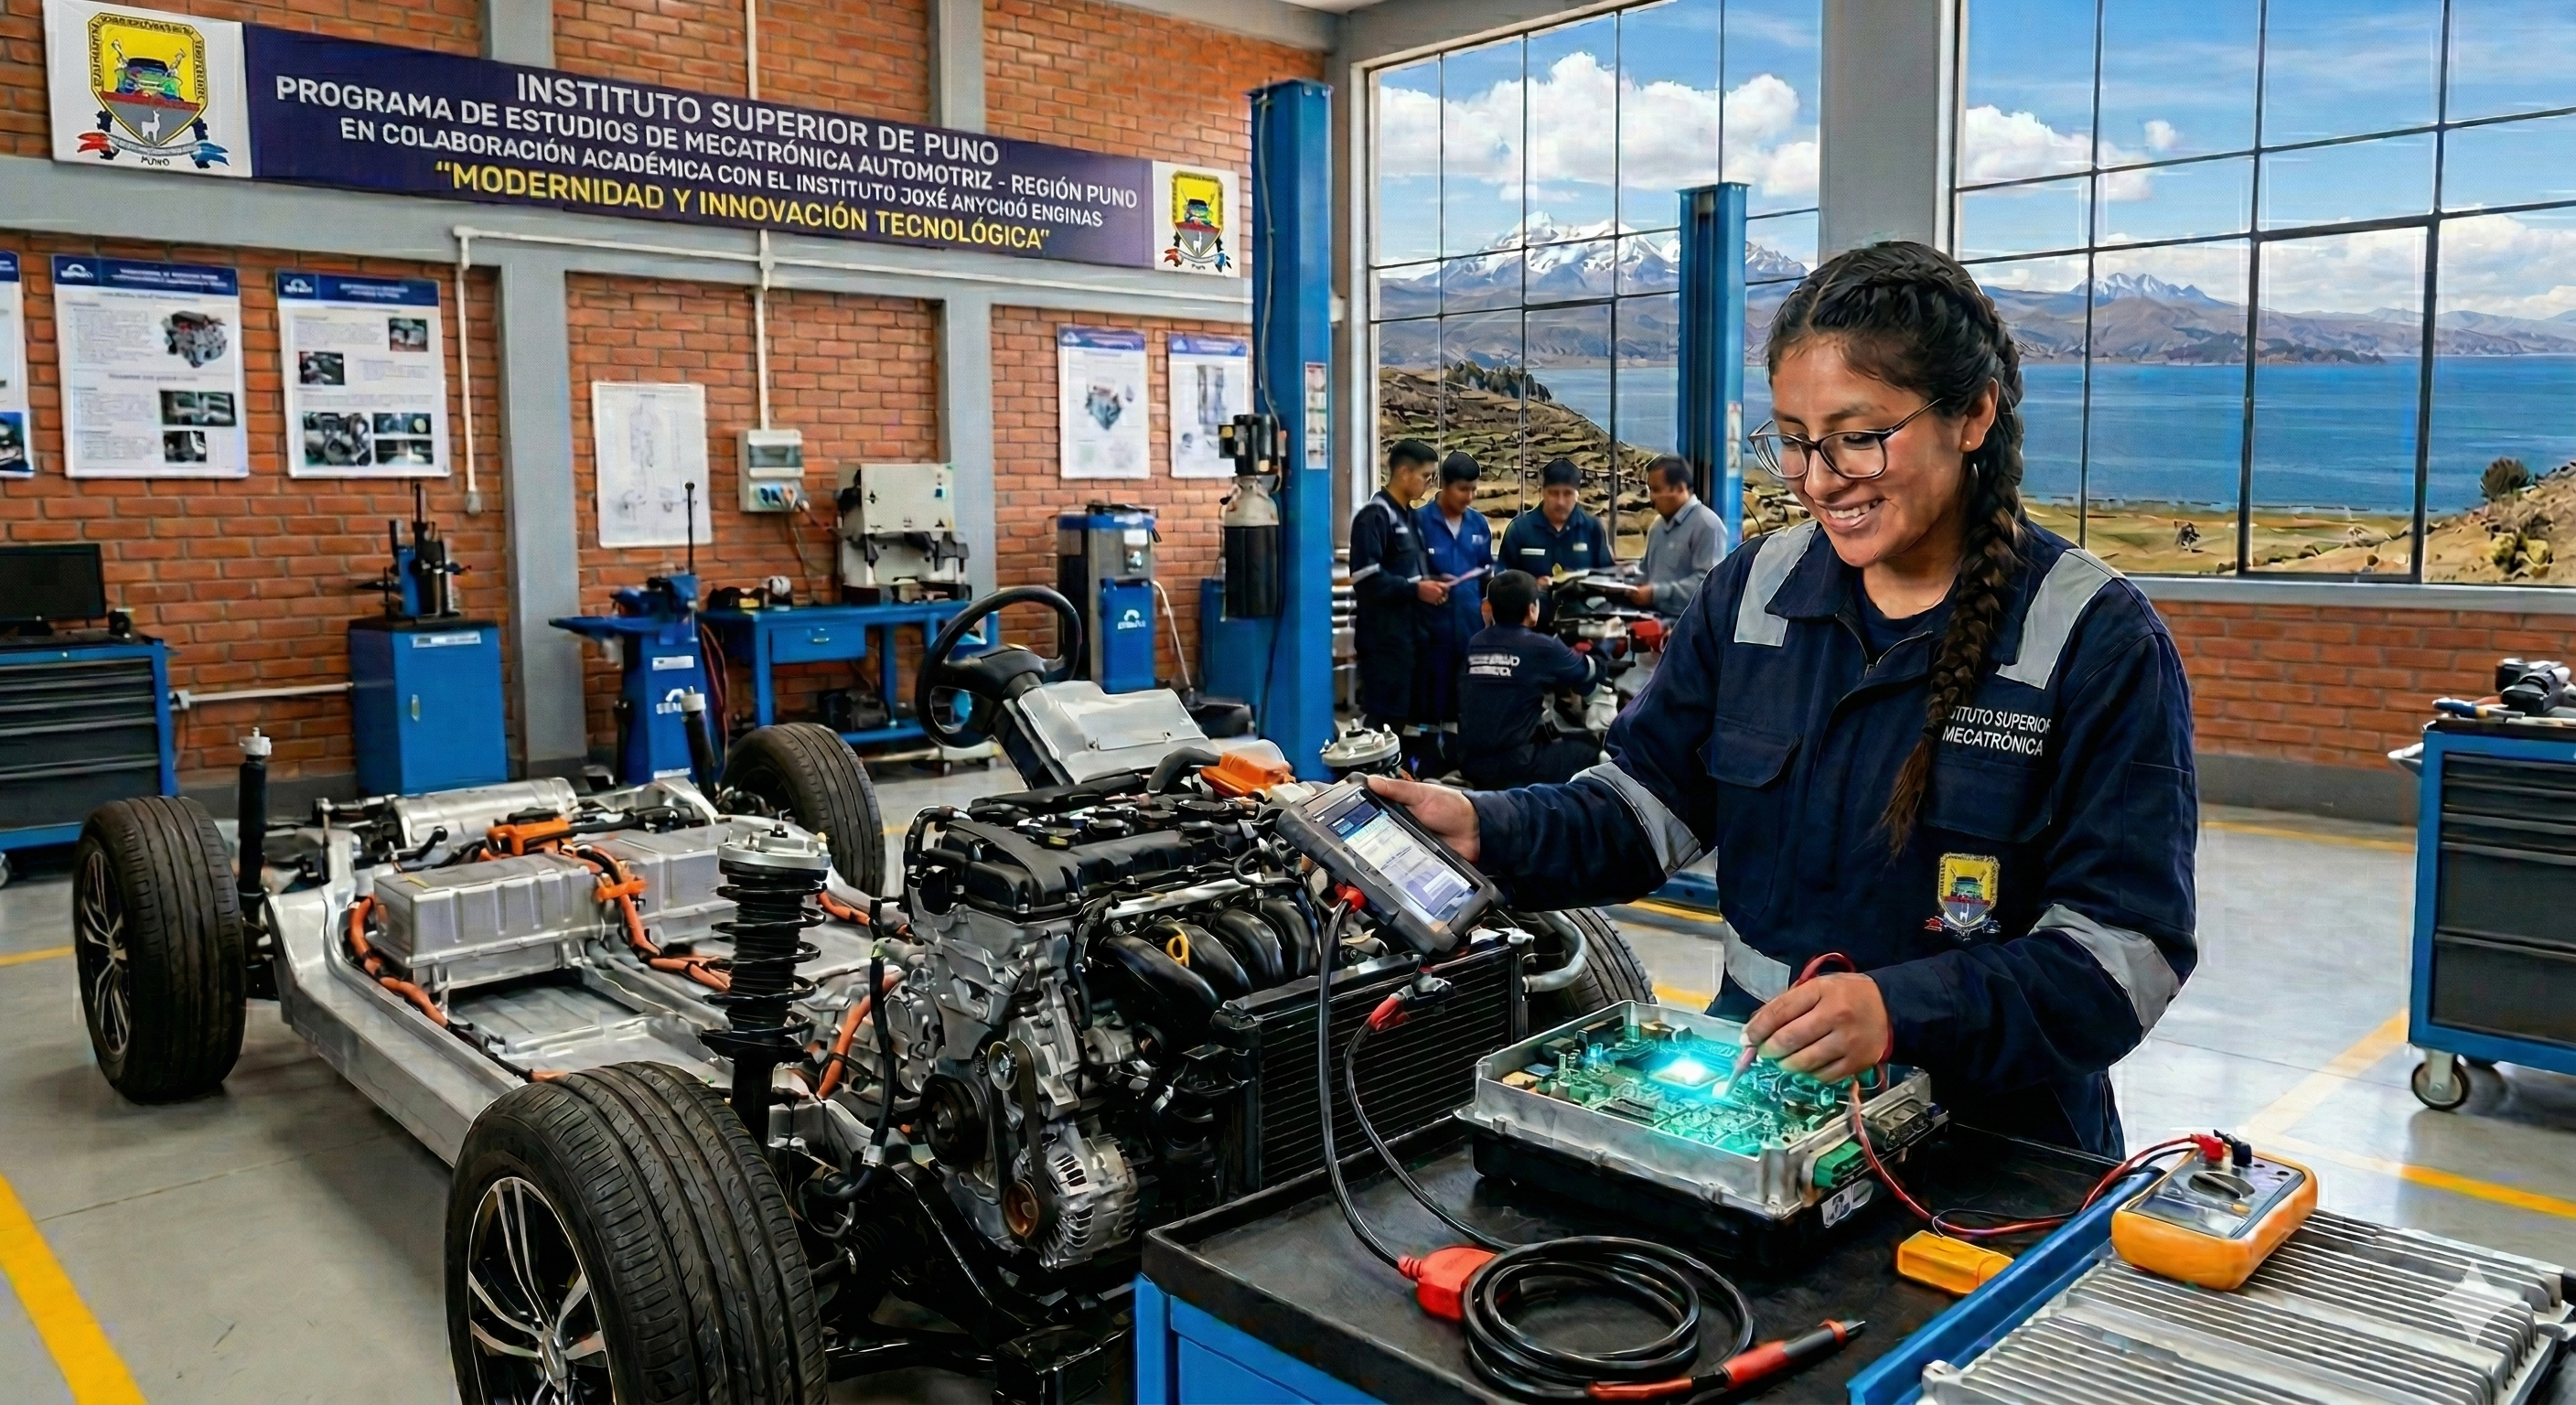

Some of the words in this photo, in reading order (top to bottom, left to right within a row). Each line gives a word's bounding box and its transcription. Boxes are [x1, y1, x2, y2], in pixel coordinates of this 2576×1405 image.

[276, 75, 454, 122] PROGRAMA
[461, 100, 499, 127] DE
[506, 105, 639, 145] ESTUDIOS
[646, 125, 679, 150] DE
[684, 130, 854, 172] MECATRÓNICA
[858, 155, 993, 190] AUTOMOTRIZ
[1012, 174, 1081, 201] REGIÓN
[1087, 185, 1137, 209] PUNO
[518, 73, 701, 124] INSTITUTO
[711, 102, 868, 147] SUPERIOR
[878, 125, 915, 155] DE
[924, 133, 999, 166] PUNO
[340, 117, 375, 142] EN
[382, 123, 576, 165] COLABORACIÓN
[582, 148, 714, 183] ACADÉMICA
[717, 165, 762, 188] CON
[767, 170, 791, 191] EL
[796, 174, 896, 202] INSTITUTO
[900, 188, 948, 209] JOXÉ
[1031, 203, 1103, 228] ENGINAS
[435, 160, 664, 209] “MODERNIDAD
[672, 187, 692, 212] Y
[699, 190, 867, 231] INNOVACIÓN
[1942, 725, 2043, 756] MECATRÓNICA
